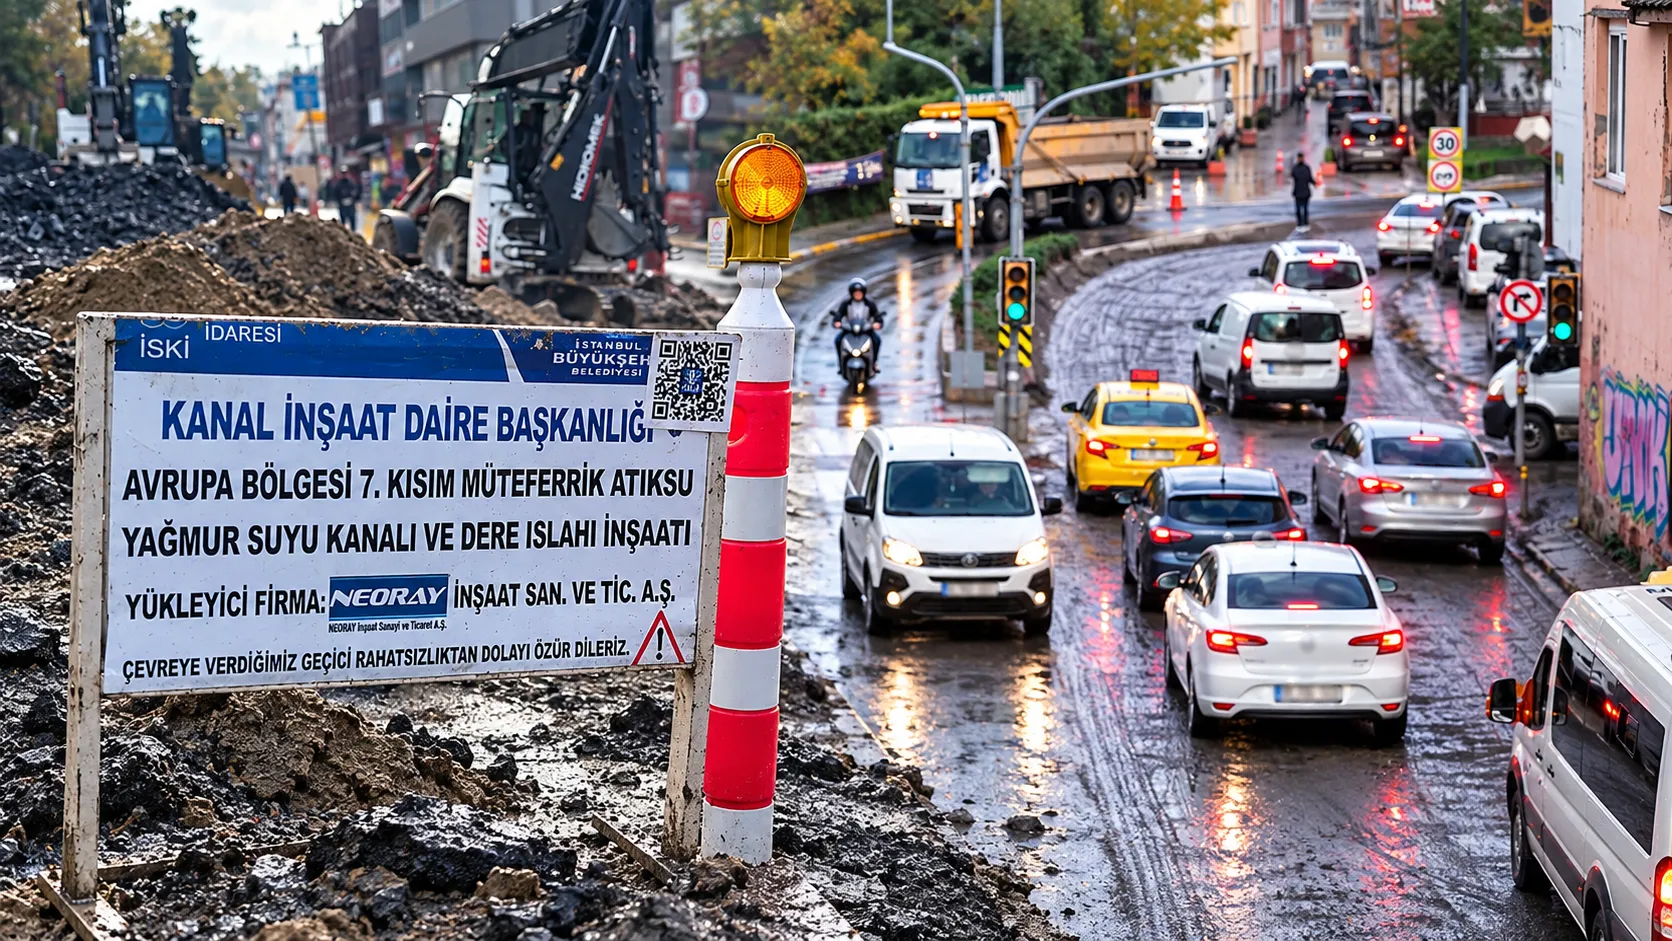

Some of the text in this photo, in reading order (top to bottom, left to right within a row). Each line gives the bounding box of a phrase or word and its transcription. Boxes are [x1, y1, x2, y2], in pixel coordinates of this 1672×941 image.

[1436, 137, 1455, 151] 30
[141, 334, 189, 358] İSKİ
[206, 322, 280, 342] İDARESİ
[575, 338, 642, 351] İSTANBUL
[162, 400, 274, 440] KANAL
[284, 393, 396, 451] İNŞAAT
[405, 396, 488, 441] DAİRE
[122, 462, 693, 500] AVRUPA BÖLGESİ 7. KISIM MÜTEFERRİK ATIKSU
[122, 513, 690, 557] YAĞMUR SUYU KANALI VE DERE ISLAHI İNŞAATI
[125, 575, 675, 619] YÜKLEYİCİ FİRMA: NEORAY İNŞAAT SAN. VE TİC. A.Ş.
[329, 623, 356, 633] NEORAY
[411, 621, 432, 629] Ticaret
[434, 620, 447, 631] A.Ş.
[123, 636, 629, 684] ÇEVREYE VERDİĞİMİZ GEÇİCİ RAHATSIZLIKTAN DOLAYI ÖZÜR DİLERİZ.
